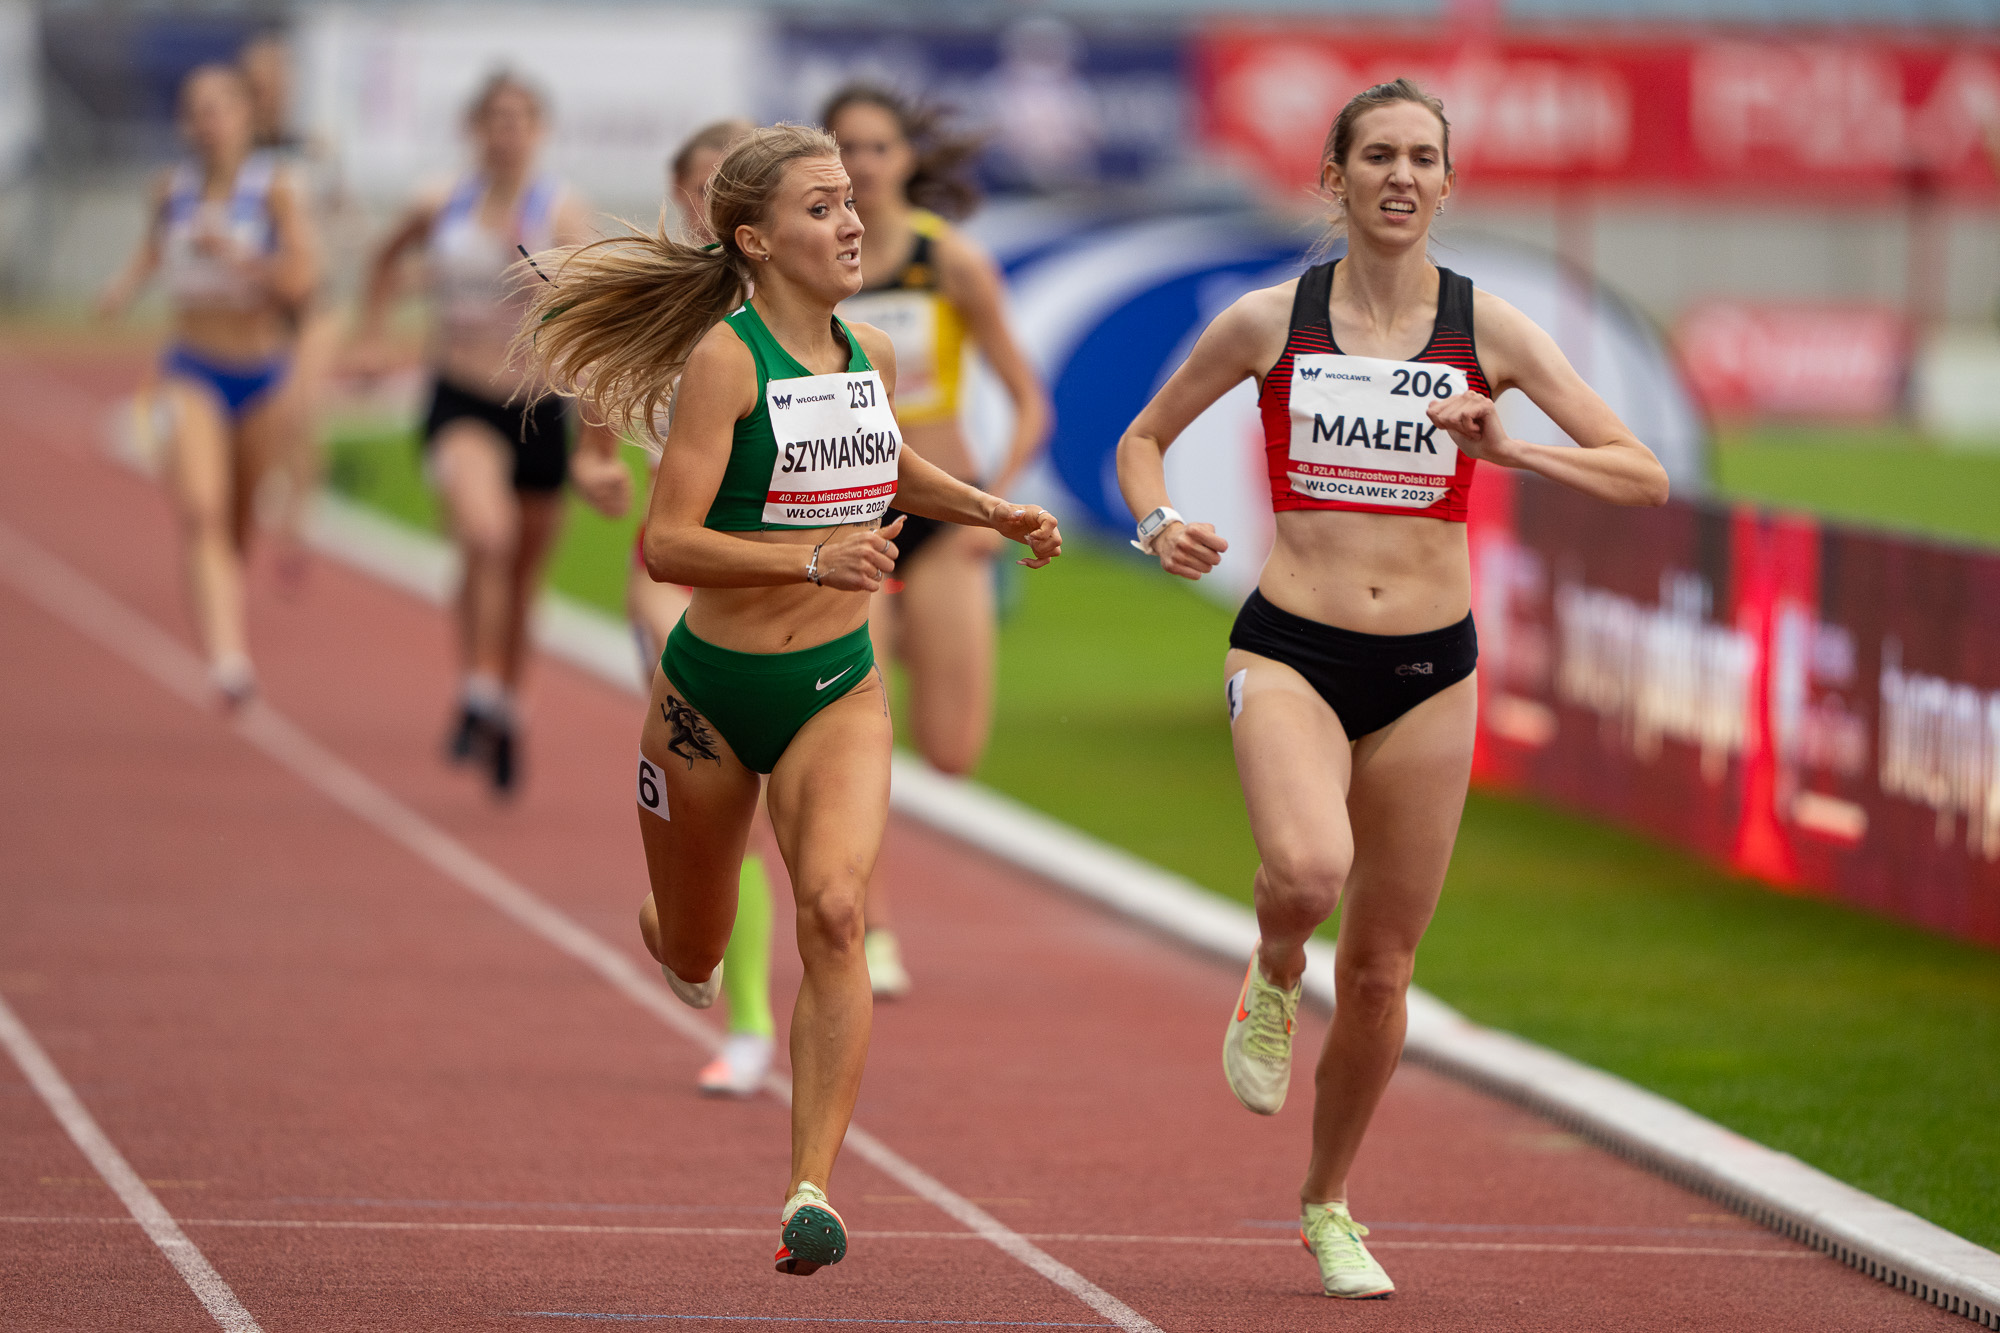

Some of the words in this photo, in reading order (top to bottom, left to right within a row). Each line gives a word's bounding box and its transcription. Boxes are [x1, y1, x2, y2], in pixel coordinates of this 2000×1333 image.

[1325, 372, 1371, 382] WŁOCŁAWEK
[1390, 369, 1453, 399] 206
[796, 393, 835, 404] WŁOCŁAWEK
[846, 380, 876, 409] 237
[1311, 413, 1438, 455] MAŁEK
[781, 427, 897, 473] SZYMAŃSKA
[1297, 463, 1311, 474] 40.
[1312, 465, 1336, 476] PZLA
[1337, 468, 1397, 482] Mistrzostwa
[1398, 474, 1427, 485] Polski
[1428, 476, 1447, 486] U23
[778, 493, 793, 502] 40.
[795, 494, 816, 503] PZLA
[817, 490, 862, 502] Mistrzostwa
[863, 486, 882, 498] Polski
[882, 483, 893, 494] U23
[1305, 479, 1398, 499] WŁOCŁAWEK
[1401, 489, 1434, 502] 2023
[786, 504, 863, 518] WŁOCŁAWEK
[866, 500, 886, 513] 2023
[639, 760, 660, 809] 6
